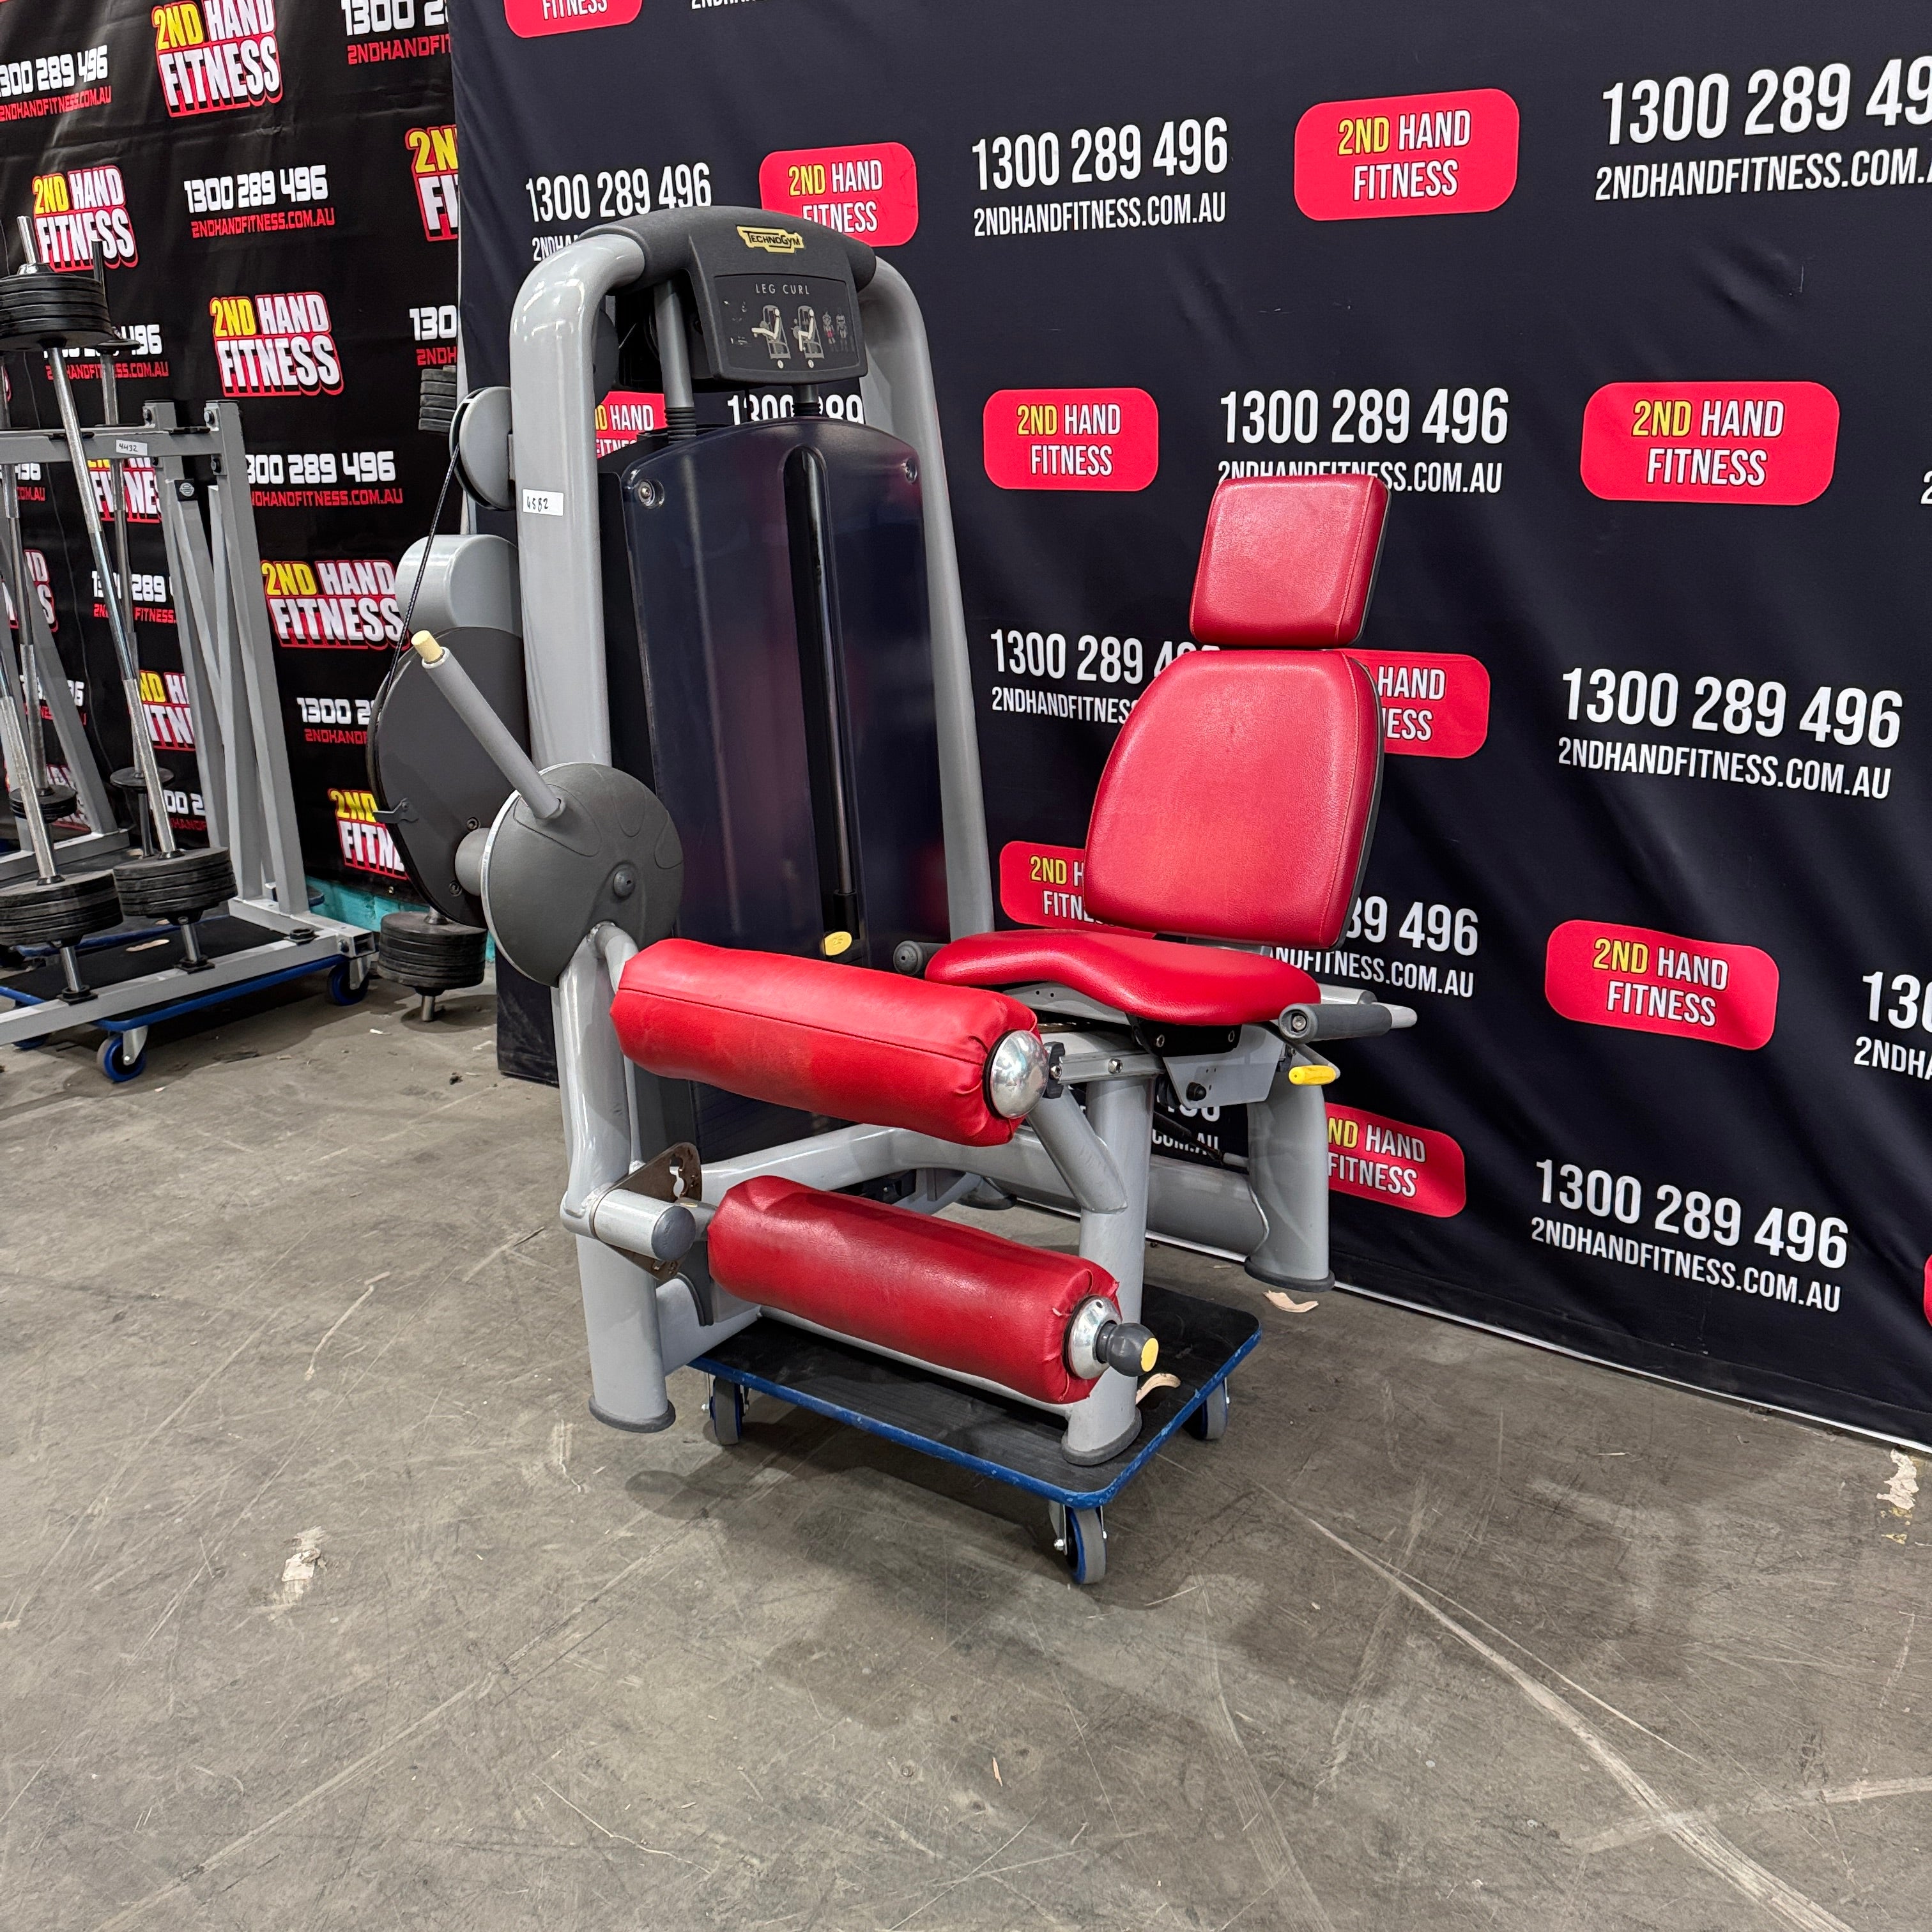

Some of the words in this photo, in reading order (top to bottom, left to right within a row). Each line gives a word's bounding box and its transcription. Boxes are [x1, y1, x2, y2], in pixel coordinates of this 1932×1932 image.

[154, 3, 204, 50] 2ND
[204, 0, 275, 41] HAND
[341, 0, 415, 36] 1300
[0, 61, 34, 97] 300
[36, 54, 75, 91] 289
[77, 45, 108, 82] 496
[159, 36, 280, 107] FITNESS
[0, 86, 111, 121] 2NDHANDFITNESS.COM.AU
[1602, 73, 1729, 144] 1300
[1744, 63, 1851, 135] 289
[1865, 56, 1932, 126] 49
[409, 127, 458, 173] 2N
[972, 132, 1059, 190] 1300
[1071, 125, 1141, 183] 289
[1153, 116, 1227, 176] 496
[1338, 117, 1390, 155] 2ND
[1398, 109, 1471, 151] HAND
[34, 176, 69, 214] 2ND
[68, 168, 125, 210] HAND
[184, 176, 233, 213] 1300
[237, 171, 276, 208] 289
[279, 165, 328, 202] 496
[525, 174, 590, 222] 1300
[597, 168, 650, 217] 289
[658, 162, 712, 209] 496
[788, 165, 826, 196] 2ND
[831, 160, 882, 193] HAND
[1353, 160, 1459, 201] FITNESS
[192, 208, 335, 238] 2NDHANDFITNESS.COM.AU
[974, 192, 1225, 236] 2NDHANDFITNESS.COM.AU
[755, 284, 776, 293] LEG
[783, 285, 809, 295] CURL
[211, 299, 256, 337] 2ND
[257, 295, 330, 334] HAND
[410, 305, 457, 341] 130
[216, 335, 340, 387] FITNESS
[610, 404, 654, 431] HAND
[1018, 404, 1057, 435] 2ND
[1064, 404, 1121, 435] HAND
[1220, 390, 1318, 443] 1300
[1332, 388, 1409, 443] 289
[1422, 388, 1508, 443] 496
[1632, 400, 1692, 436] 2ND
[1701, 401, 1784, 438] HAND
[245, 454, 284, 484] 300
[288, 453, 337, 484] 289
[342, 450, 396, 482] 496
[1031, 445, 1113, 476] FITNESS
[1647, 448, 1767, 486] FITNESS
[132, 574, 166, 602] 289
[261, 562, 318, 595] 2ND
[317, 562, 395, 595] HAND
[269, 598, 406, 641] FITNESS
[990, 629, 1066, 679] 1300
[1077, 635, 1143, 684] 289
[1377, 666, 1445, 700] HAND
[296, 698, 351, 724] 1300
[1562, 667, 1679, 727] 1300
[1692, 676, 1786, 737] 289
[1799, 686, 1903, 748] 496
[1558, 737, 1891, 799] 2NDHANDFITNESS.COM.AU
[1030, 855, 1067, 885] 2ND
[1399, 901, 1478, 956] 496
[1593, 938, 1648, 974] 2ND
[1657, 947, 1729, 990] HAND
[1607, 980, 1716, 1027] FITNESS
[1862, 971, 1932, 1033] 13
[1328, 1117, 1358, 1148] ND
[1365, 1124, 1425, 1163] HAND
[1328, 1152, 1417, 1197] FITNESS
[1536, 1159, 1641, 1224] 1300
[1655, 1184, 1742, 1246] 289
[1754, 1208, 1848, 1269] 496
[1531, 1216, 1841, 1312] 2NDHANDFITNESS.COM.AU
